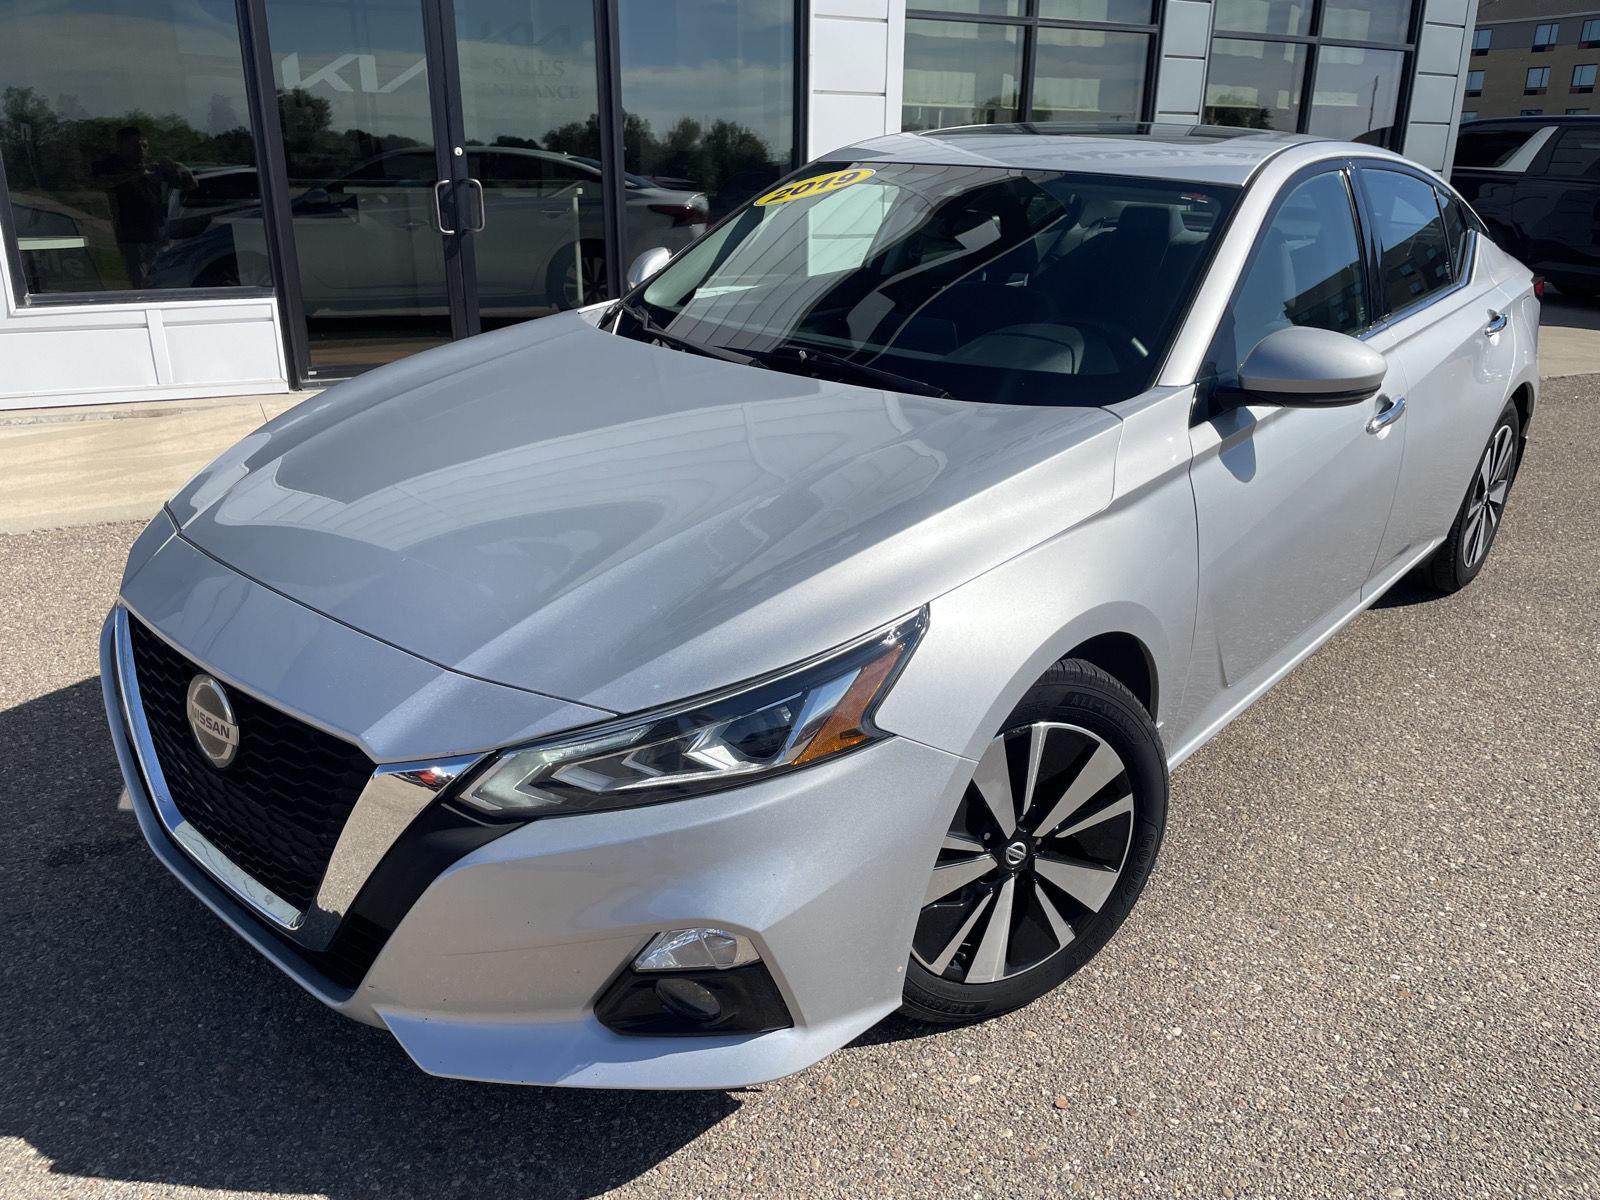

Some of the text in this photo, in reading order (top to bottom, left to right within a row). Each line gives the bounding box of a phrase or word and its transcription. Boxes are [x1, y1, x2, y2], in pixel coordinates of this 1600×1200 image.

[492, 57, 566, 78] SALES
[765, 171, 862, 203] 2019
[191, 704, 230, 739] NISSAN
